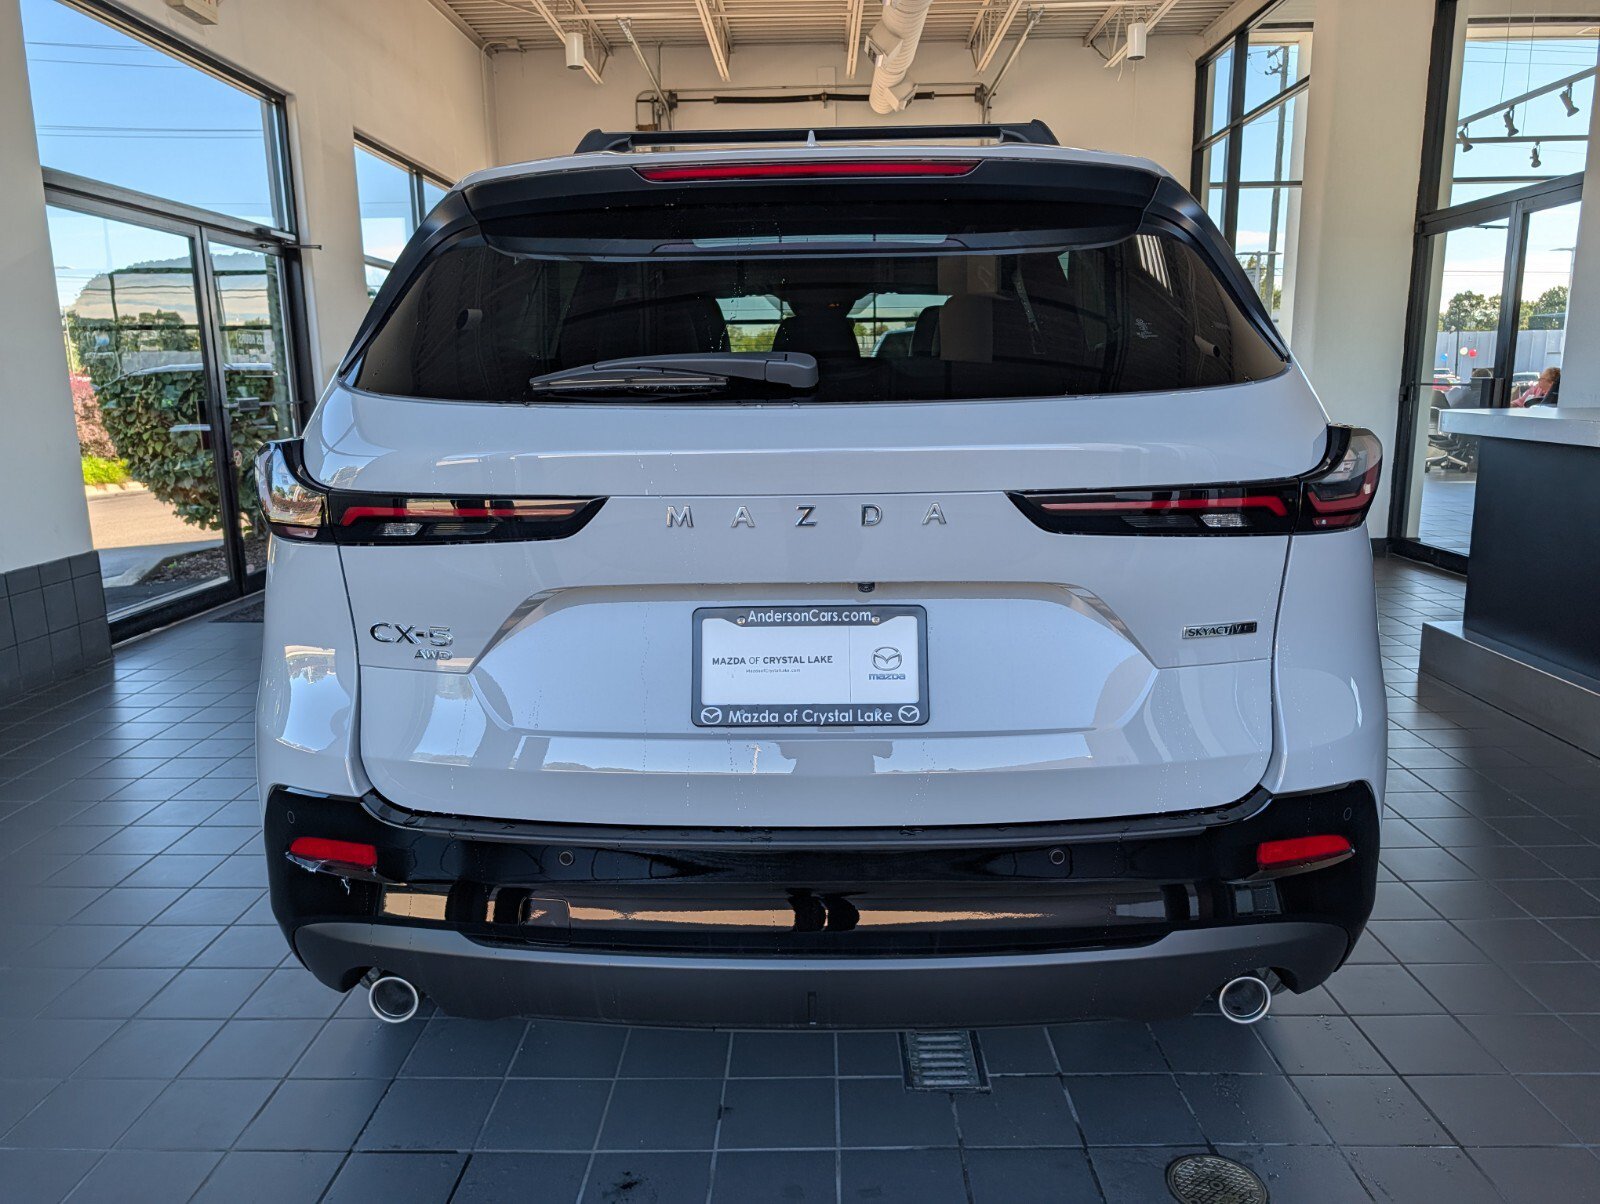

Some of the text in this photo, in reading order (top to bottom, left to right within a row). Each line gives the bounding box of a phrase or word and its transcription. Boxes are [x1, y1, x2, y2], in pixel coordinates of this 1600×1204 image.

[666, 502, 947, 528] MAZDA
[747, 609, 872, 623] AndersonCars.com
[369, 622, 453, 647] CX-5
[414, 649, 452, 660] AWD
[712, 655, 833, 665] MAZDA OF CRYSTAL LAKE
[728, 707, 892, 725] Mazda of Crystal Lake
